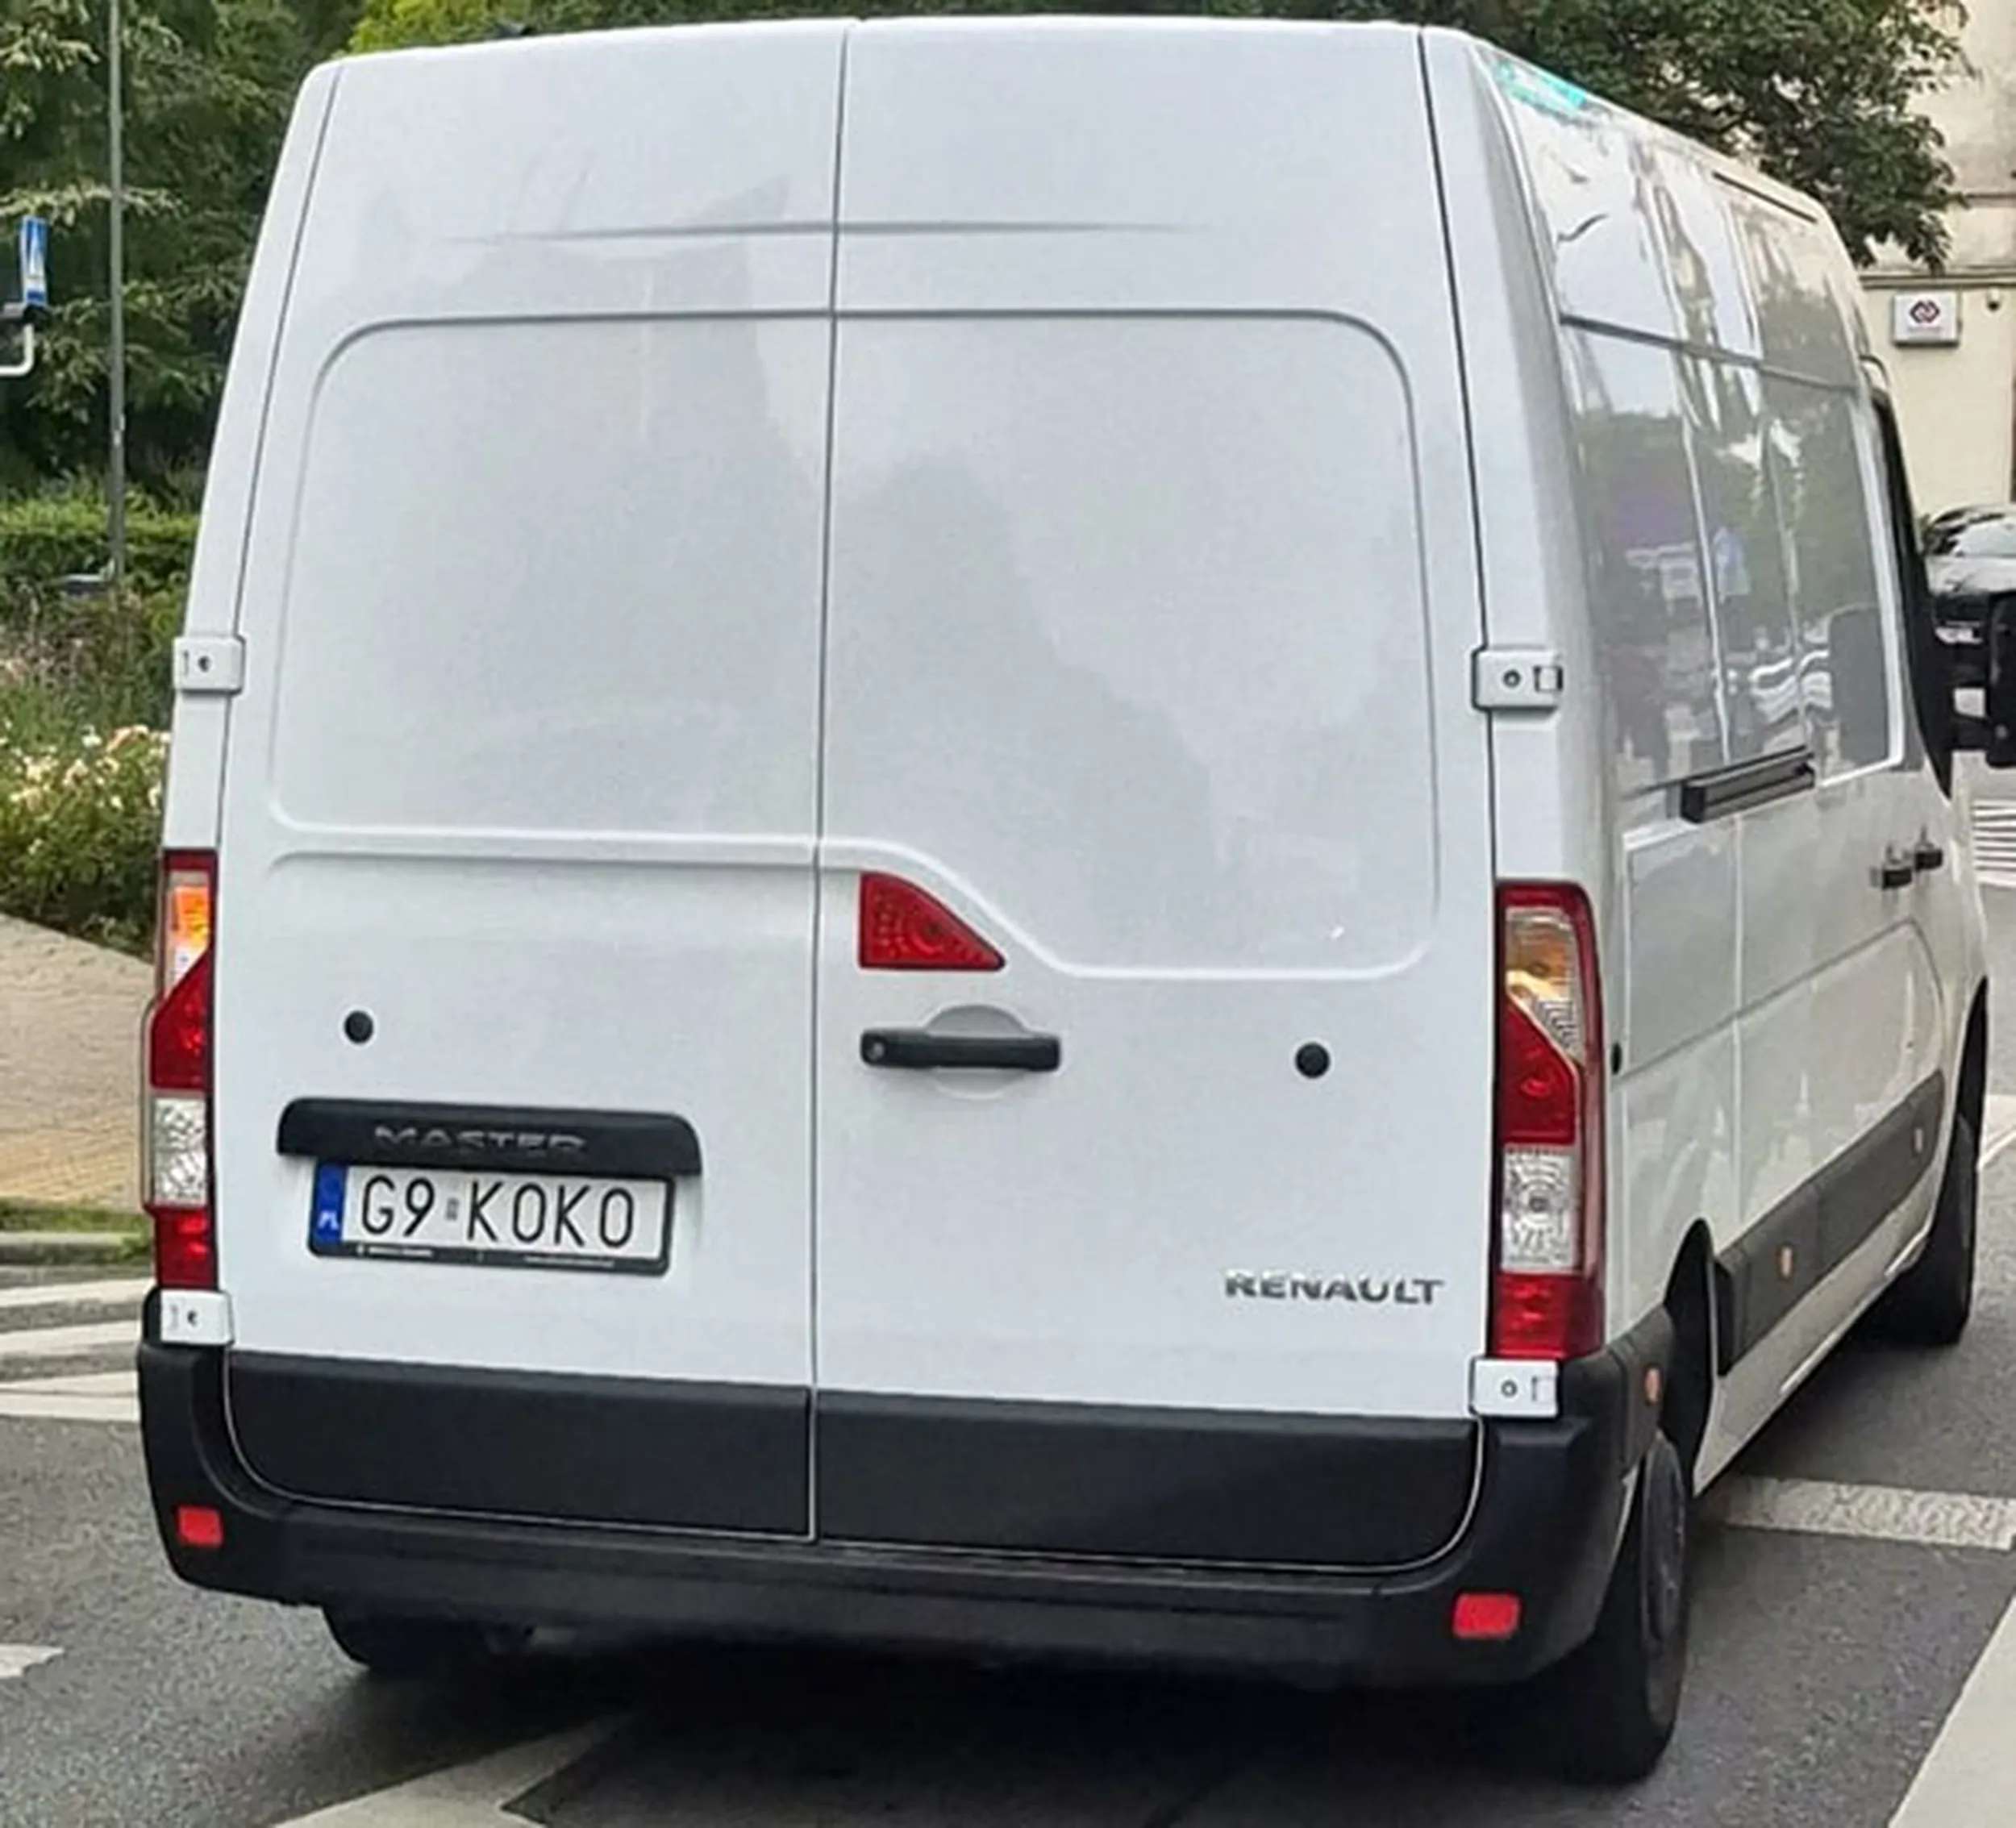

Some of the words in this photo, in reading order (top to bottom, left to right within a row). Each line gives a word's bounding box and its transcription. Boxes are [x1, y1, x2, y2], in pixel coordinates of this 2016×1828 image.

[374, 1126, 588, 1156] MASTER
[362, 1175, 435, 1237] G9
[1224, 1271, 1446, 1305] RENAULT
